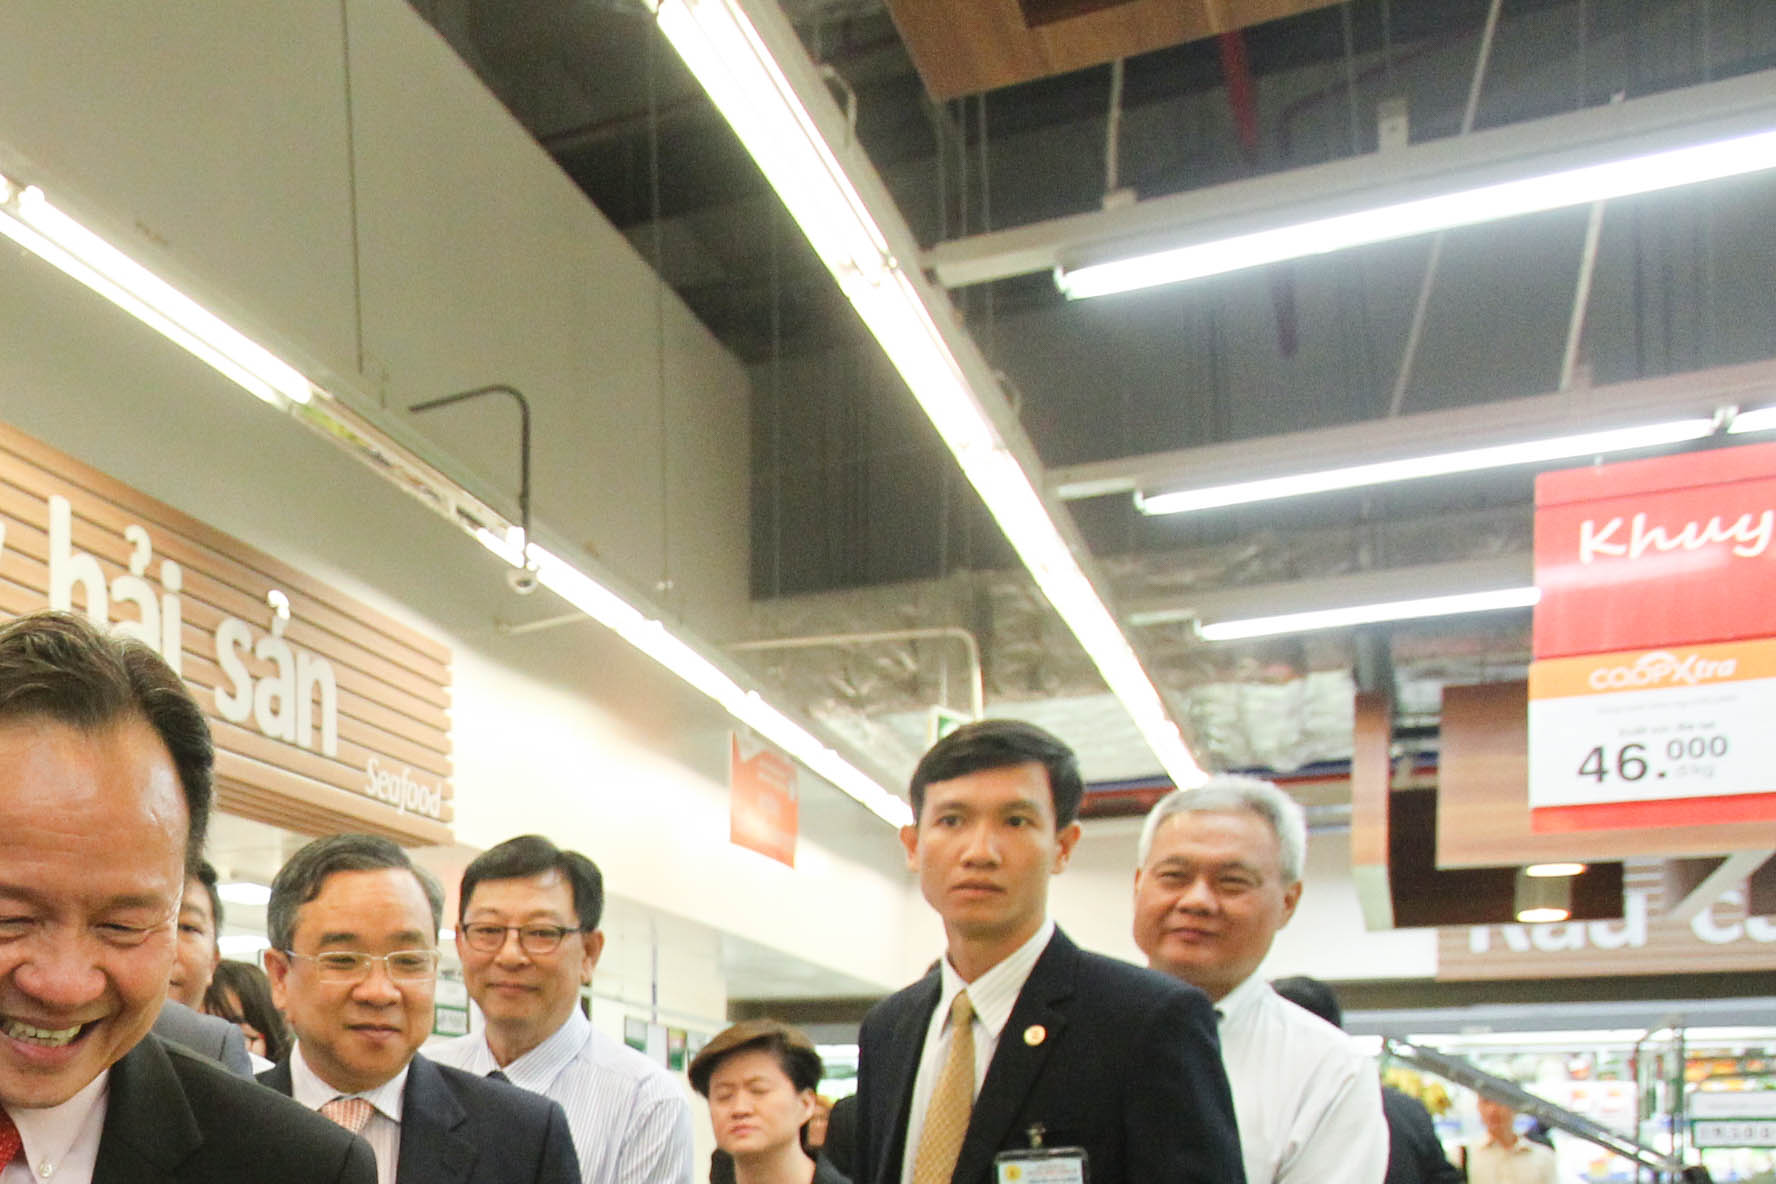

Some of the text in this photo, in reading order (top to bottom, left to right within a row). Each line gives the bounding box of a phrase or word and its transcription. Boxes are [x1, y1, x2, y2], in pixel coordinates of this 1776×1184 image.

[1579, 509, 1774, 565] Khuy
[214, 589, 338, 756] sản
[364, 757, 442, 817] Seafood
